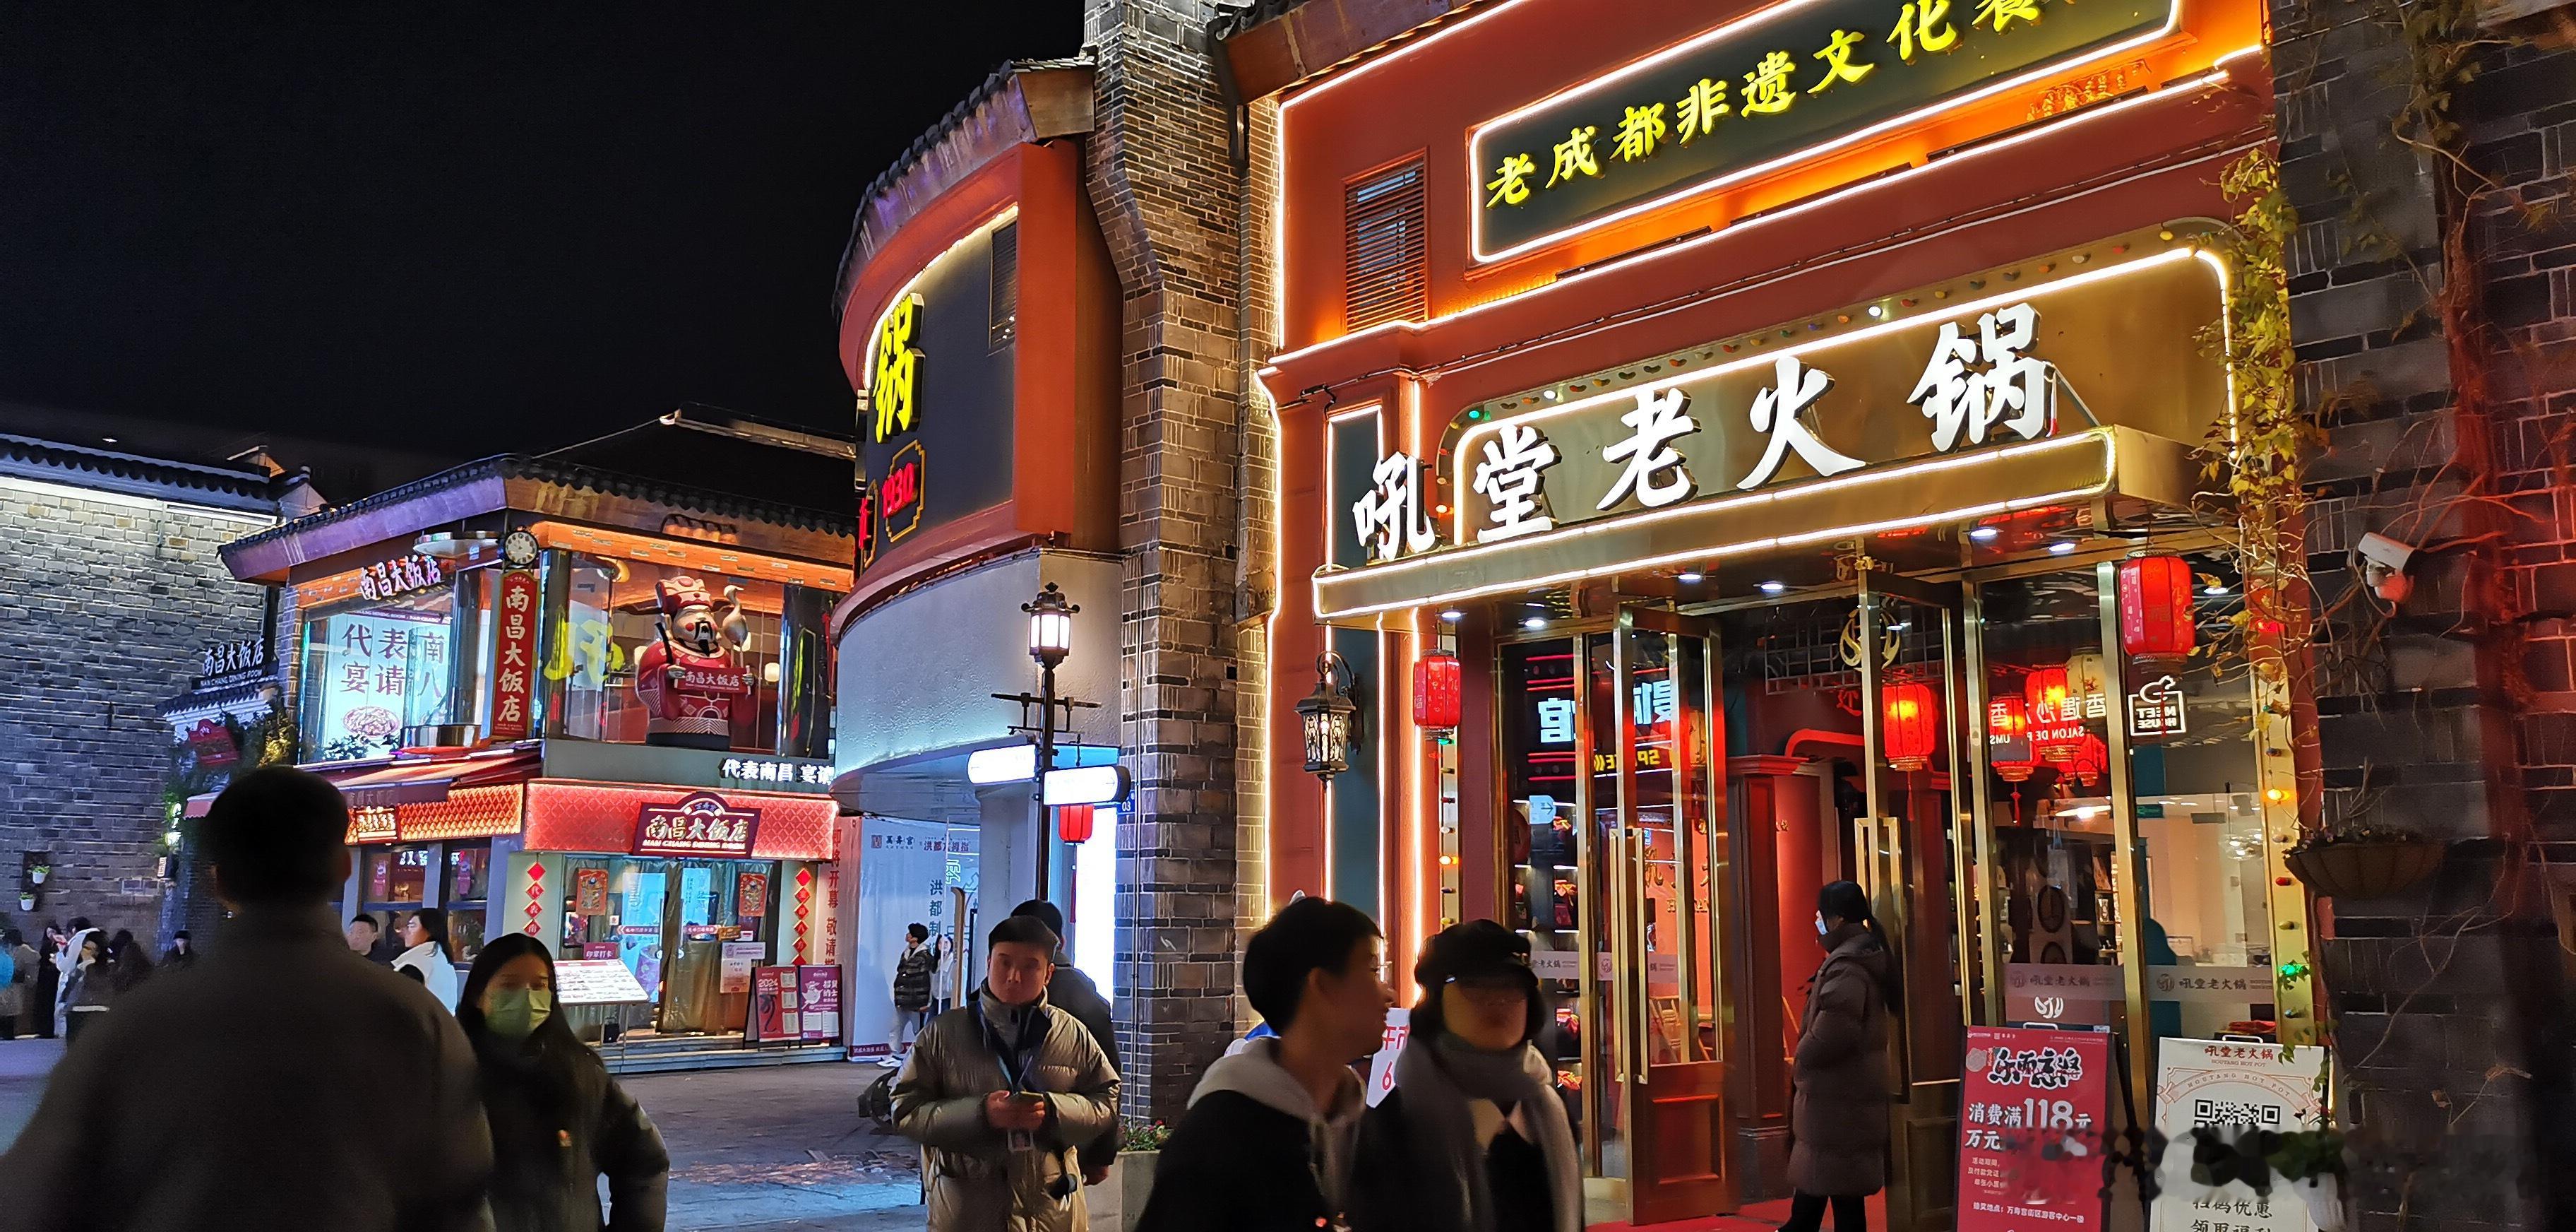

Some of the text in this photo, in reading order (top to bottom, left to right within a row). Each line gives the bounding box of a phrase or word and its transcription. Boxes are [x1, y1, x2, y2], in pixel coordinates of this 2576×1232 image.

[1352, 304, 2045, 561] 吼堂老火锅
[882, 463, 914, 518] 1930
[360, 554, 442, 600] 南昌大饭店
[200, 637, 264, 676] 南昌大饭店
[498, 585, 530, 722] 南昌大饭店
[685, 670, 740, 687] 南昌大饭店
[722, 759, 793, 782] 代表南昌
[645, 815, 749, 842] 南昌大饭店
[2029, 973, 2090, 987] 吼堂老火锅
[2178, 978, 2247, 990] 吼堂老火锅
[2204, 1045, 2274, 1060] 吼堂老火锅
[2188, 1072, 2291, 1098] HOUTANG HOT POT
[2190, 1219, 2272, 1232] 领取
